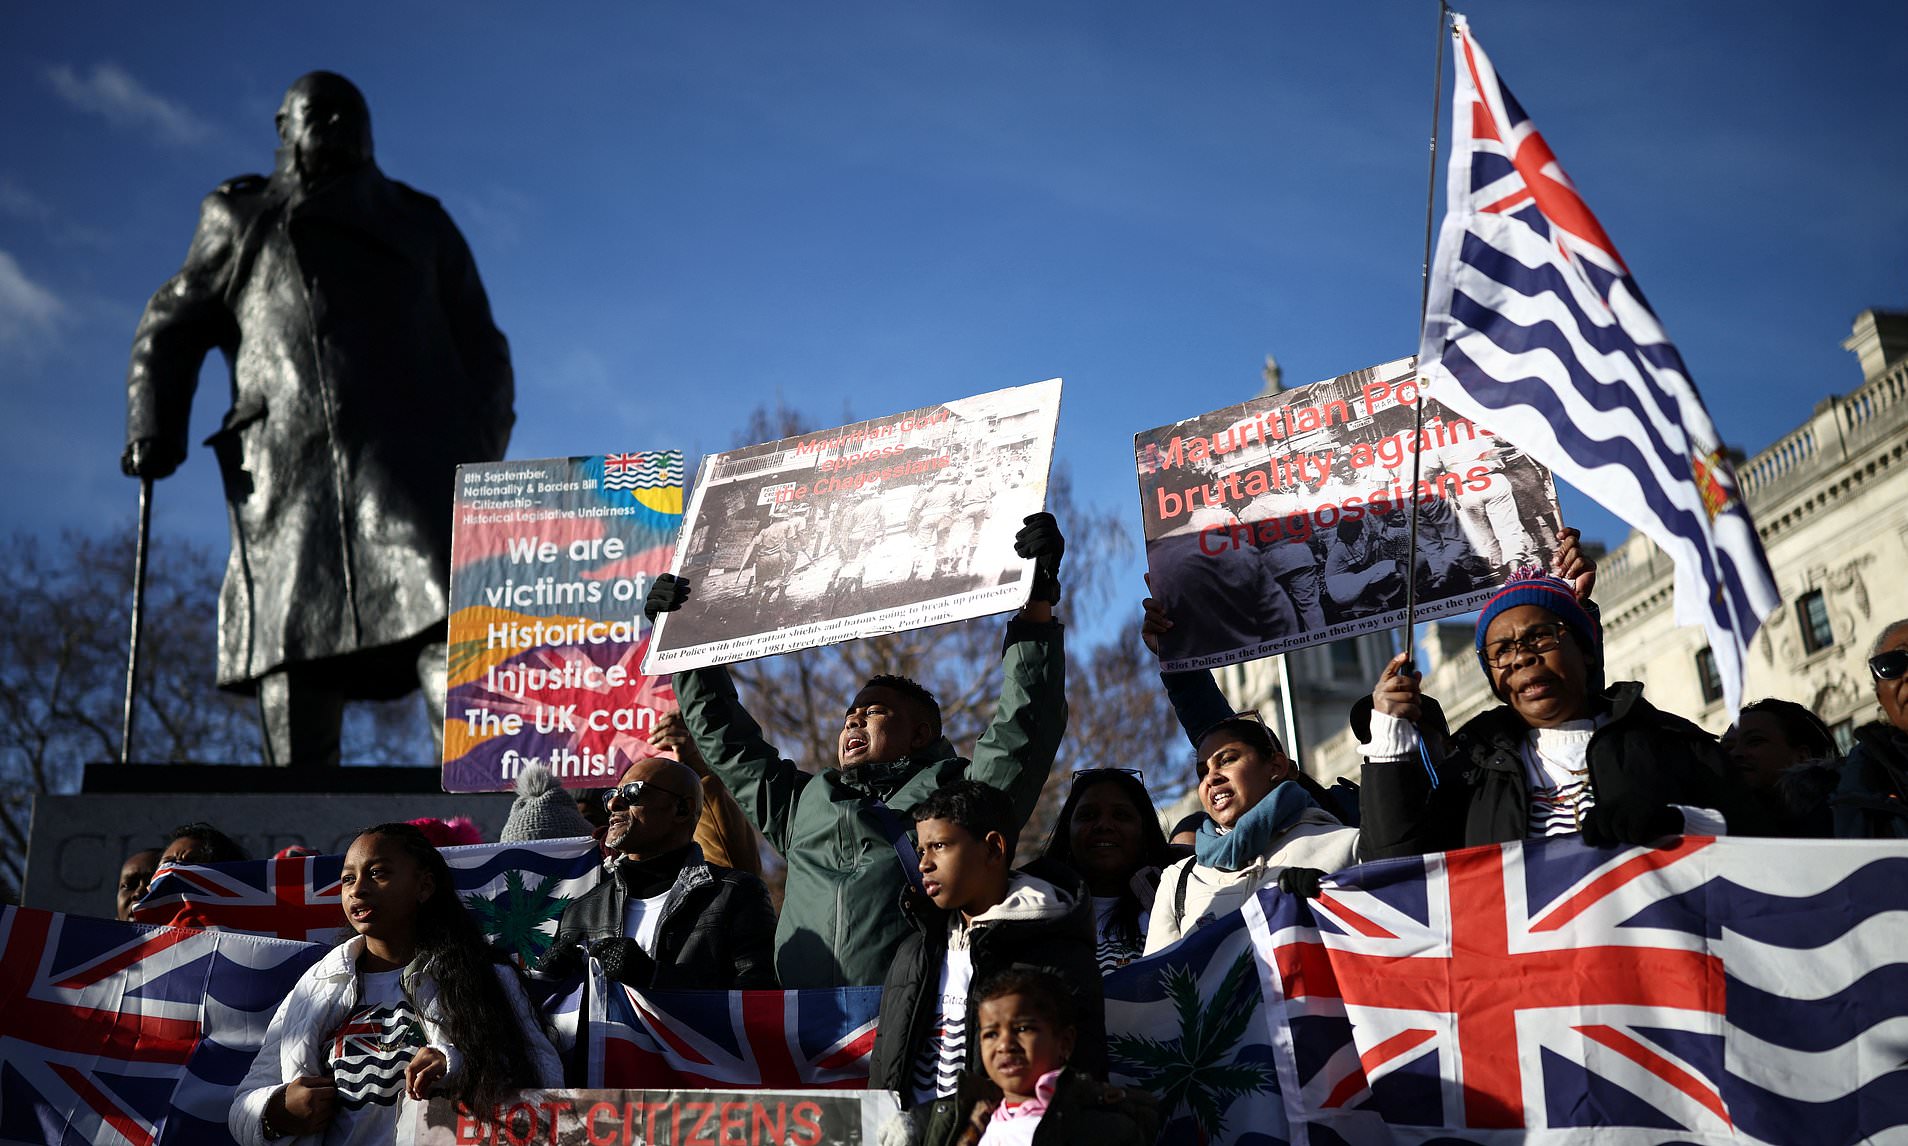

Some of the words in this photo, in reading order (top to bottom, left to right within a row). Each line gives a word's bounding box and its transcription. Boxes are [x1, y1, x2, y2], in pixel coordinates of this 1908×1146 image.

[796, 424, 894, 456] Mauritian
[900, 409, 949, 433] Govt
[1145, 398, 1349, 474] Mauritian
[1362, 381, 1419, 415] Po
[464, 473, 481, 484] 8th
[775, 484, 808, 504] the
[813, 455, 950, 495] Chagossians
[1157, 446, 1332, 520] brutality
[1350, 415, 1496, 469] again
[463, 484, 523, 497] Nationality
[526, 484, 534, 494] &
[538, 481, 579, 493] Borders
[582, 479, 598, 490] Bill
[472, 497, 532, 510] Citizenship
[462, 512, 514, 525] Historical
[516, 508, 575, 523] Legislative
[578, 505, 636, 519] Unfairness
[1199, 464, 1492, 557] Chagossians
[508, 536, 558, 565] We
[568, 536, 624, 562] are
[485, 576, 601, 608] victims
[612, 571, 646, 600] of
[487, 615, 640, 650] Historical
[658, 651, 677, 661] Riot
[680, 646, 706, 658] Police
[709, 642, 730, 655] with
[732, 639, 754, 651] their
[789, 625, 822, 640] shields
[824, 620, 841, 631] and
[844, 616, 876, 627] batons
[879, 609, 906, 621] going
[921, 601, 950, 612] break
[953, 597, 966, 606] up
[968, 586, 1018, 603] protesters
[711, 652, 743, 664] during
[746, 646, 761, 657] the
[763, 643, 785, 655] 1981
[788, 638, 815, 650] street
[899, 618, 920, 628] Port
[1167, 662, 1189, 670] Riot
[1191, 657, 1223, 668] Police
[1225, 653, 1236, 662] in
[1238, 648, 1256, 660] the
[1258, 635, 1311, 654] fore-front
[1313, 631, 1327, 641] on
[1329, 623, 1356, 638] their
[1358, 617, 1380, 630] way
[1383, 614, 1394, 624] to
[1396, 604, 1443, 621] diperse
[1445, 598, 1464, 609] the
[1466, 591, 1496, 606] prote
[487, 659, 636, 698] Injustice.
[465, 707, 523, 737] The
[535, 704, 577, 736] UK
[588, 706, 656, 732] can
[549, 746, 615, 778] this!
[586, 1101, 823, 1146] CITIZENS
